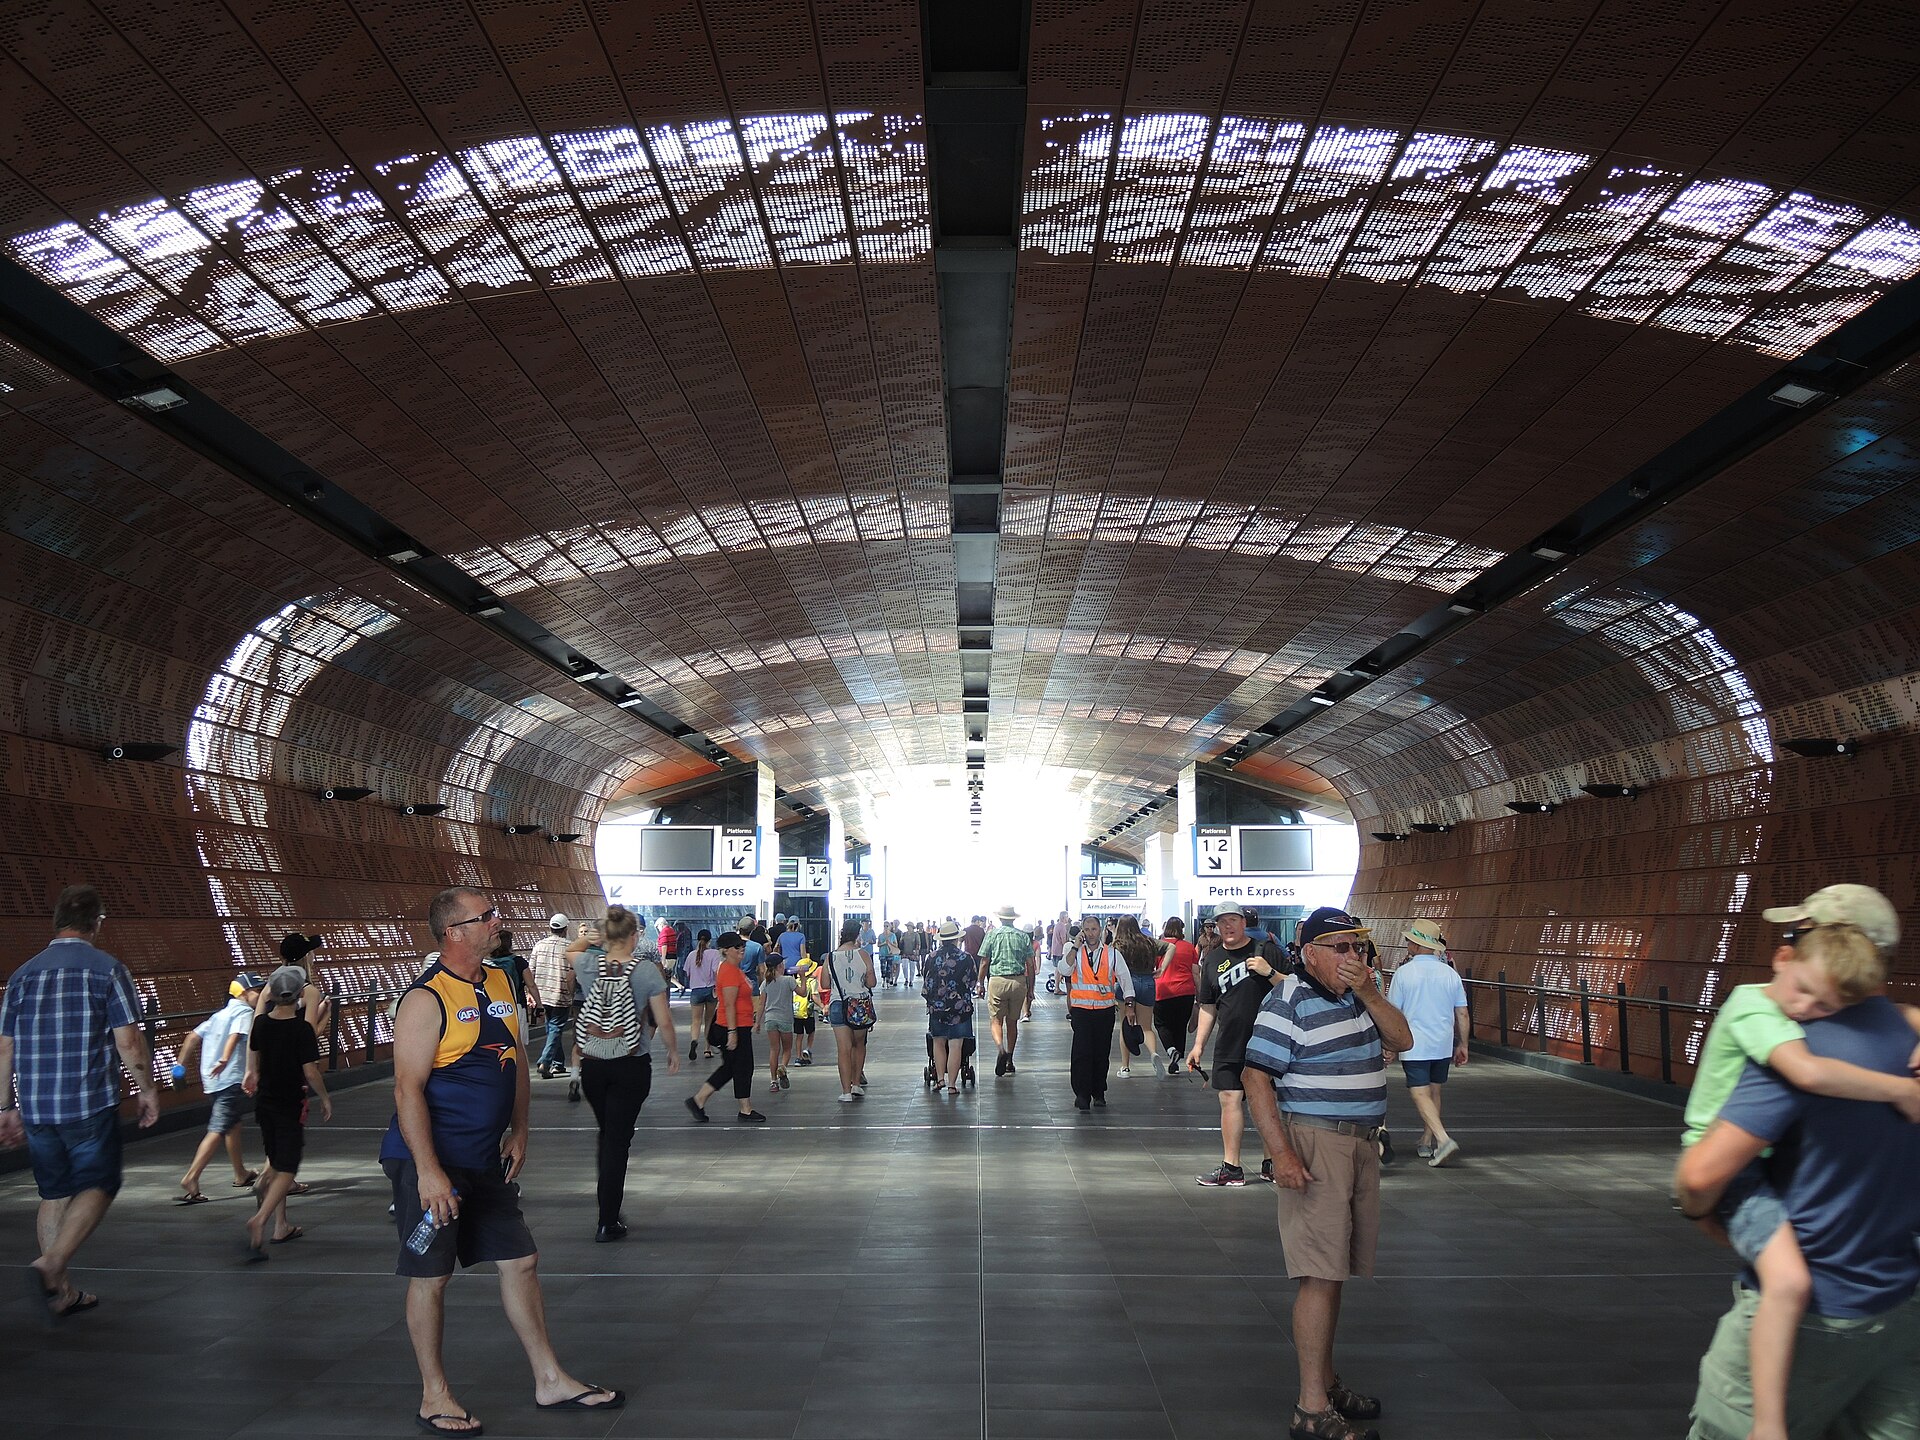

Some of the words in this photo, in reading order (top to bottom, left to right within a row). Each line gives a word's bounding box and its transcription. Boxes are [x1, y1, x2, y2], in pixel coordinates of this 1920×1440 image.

[728, 839, 733, 852] 1
[742, 839, 752, 852] 2
[1203, 839, 1208, 852] 1
[1218, 839, 1228, 852] 2
[809, 866, 816, 875] 3
[820, 866, 827, 875] 4
[659, 886, 692, 896] Perth
[697, 886, 745, 898] Express
[1209, 886, 1242, 896] Perth
[1247, 886, 1295, 898] Express
[460, 1009, 479, 1021] AFL
